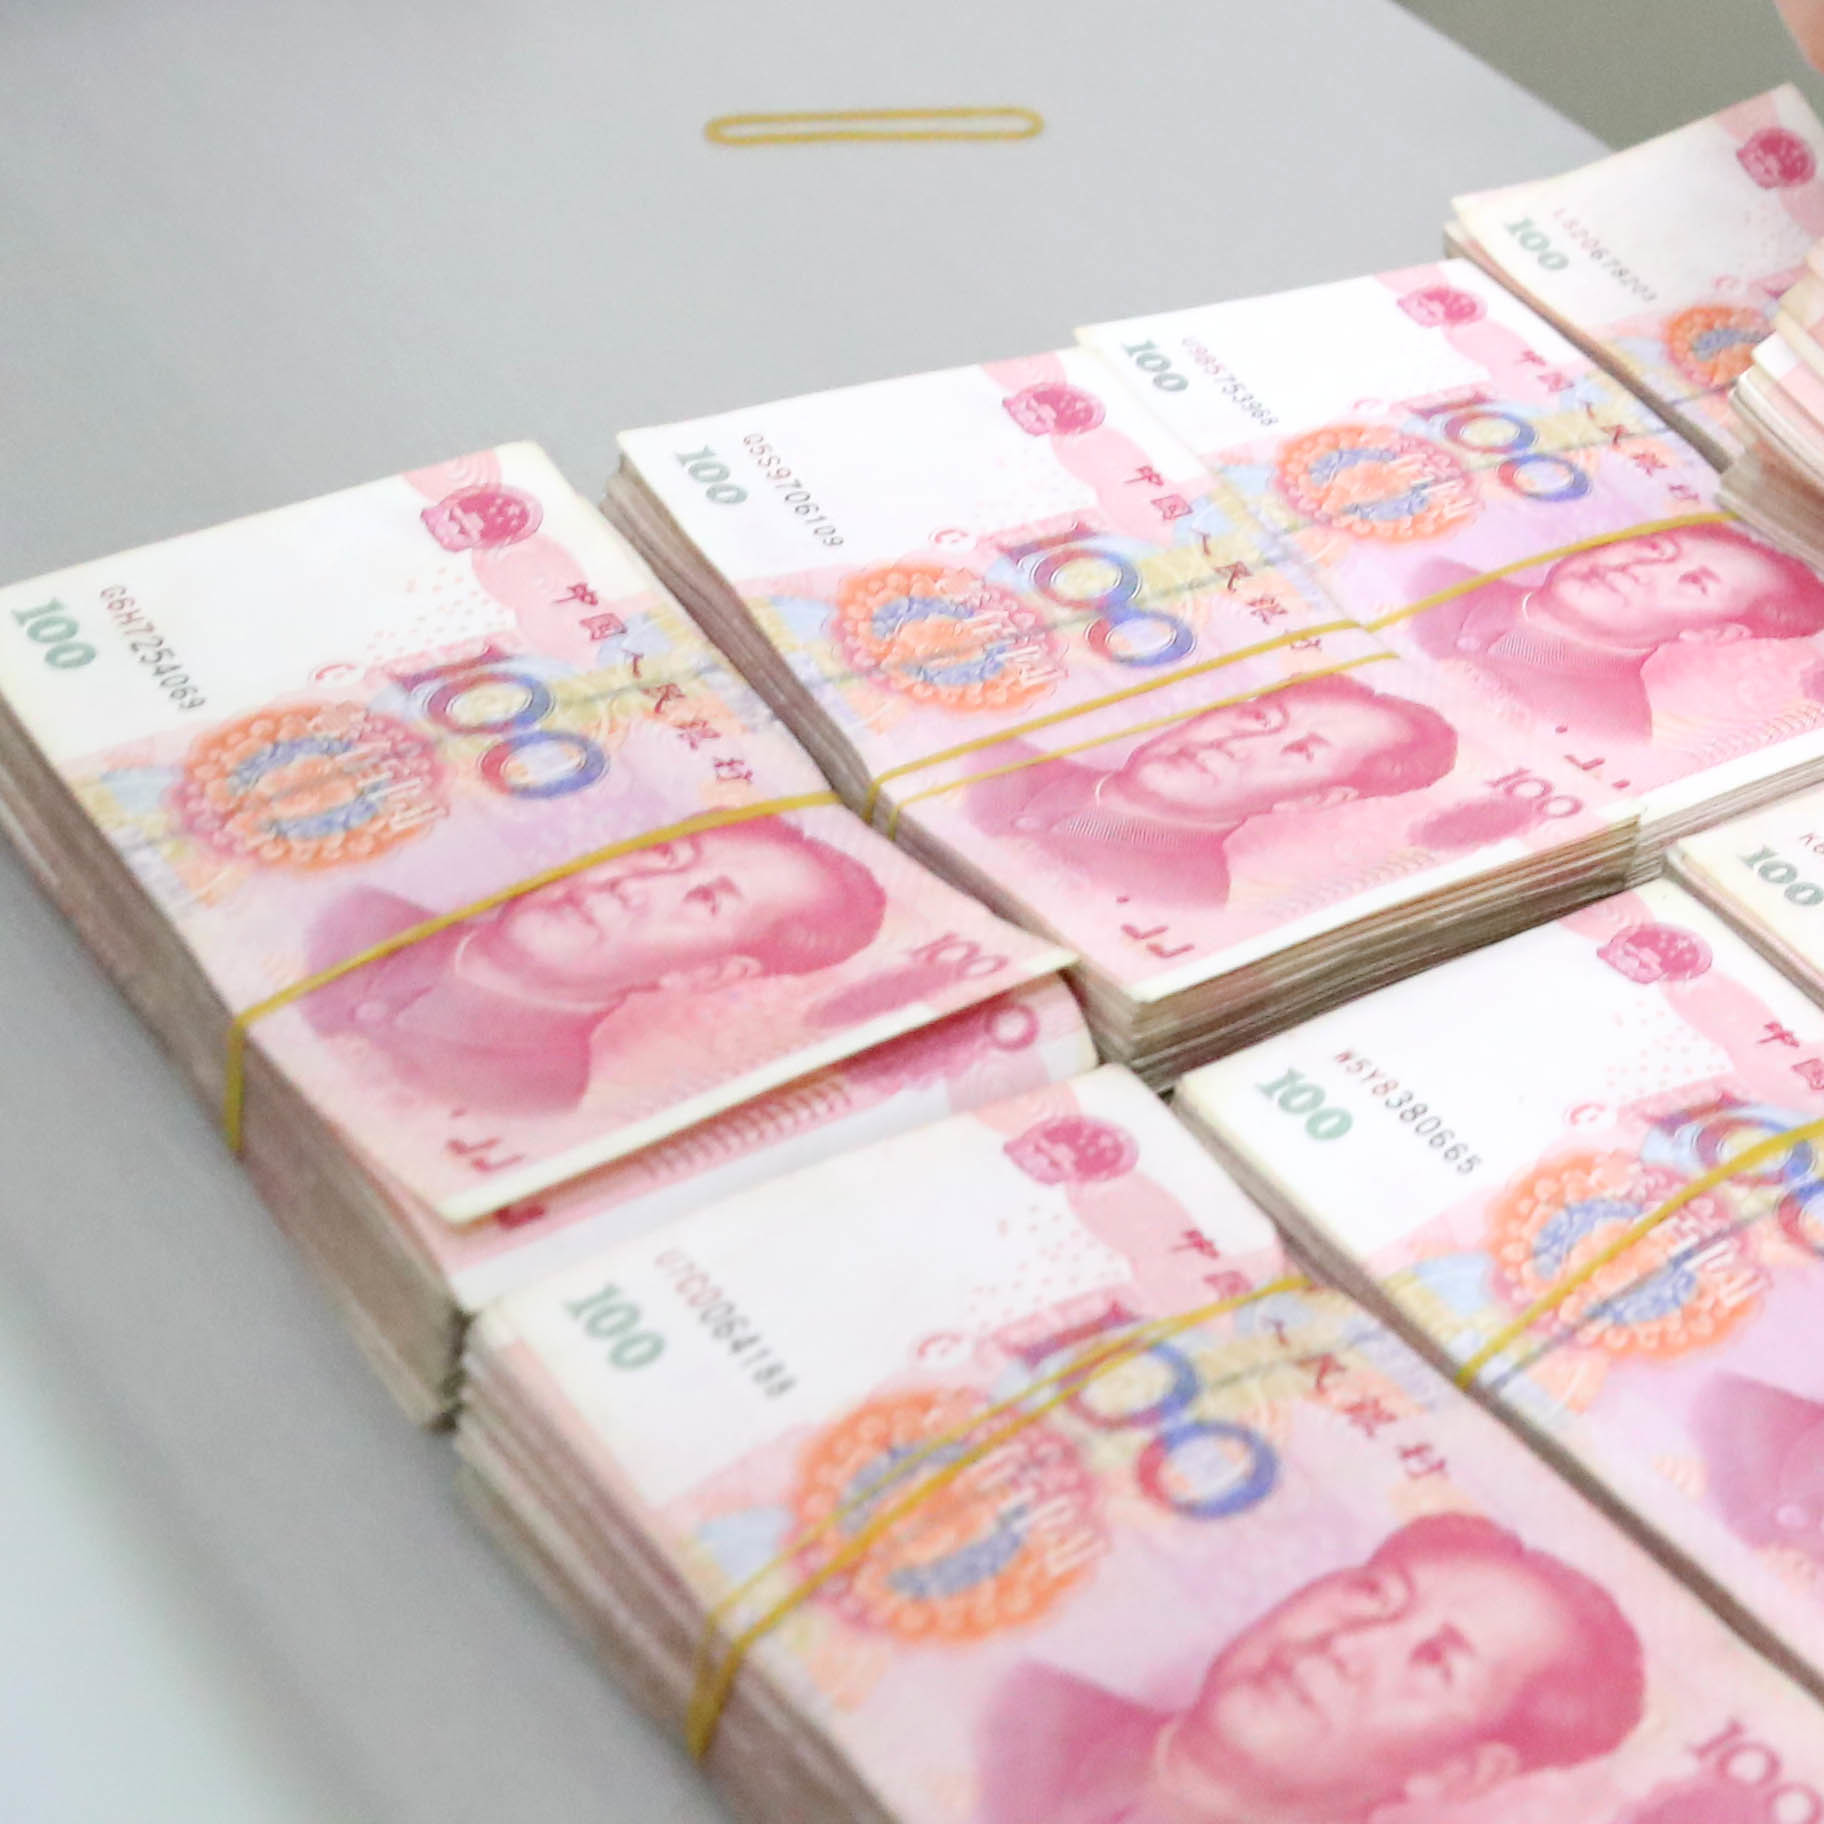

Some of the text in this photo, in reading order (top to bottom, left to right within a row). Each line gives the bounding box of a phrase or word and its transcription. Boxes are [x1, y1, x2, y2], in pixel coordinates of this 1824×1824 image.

[1504, 218, 1569, 272] 100
[1121, 339, 1190, 393] 100
[674, 444, 748, 506] 100
[1408, 392, 1593, 502] 100
[1002, 522, 1197, 668] 100
[12, 597, 96, 670] 100
[385, 641, 610, 800] 100
[1489, 766, 1583, 820] 100
[909, 932, 1007, 979] 100
[1255, 1066, 1354, 1141] 100
[563, 1283, 665, 1371] 100
[1015, 1300, 1278, 1518] 100
